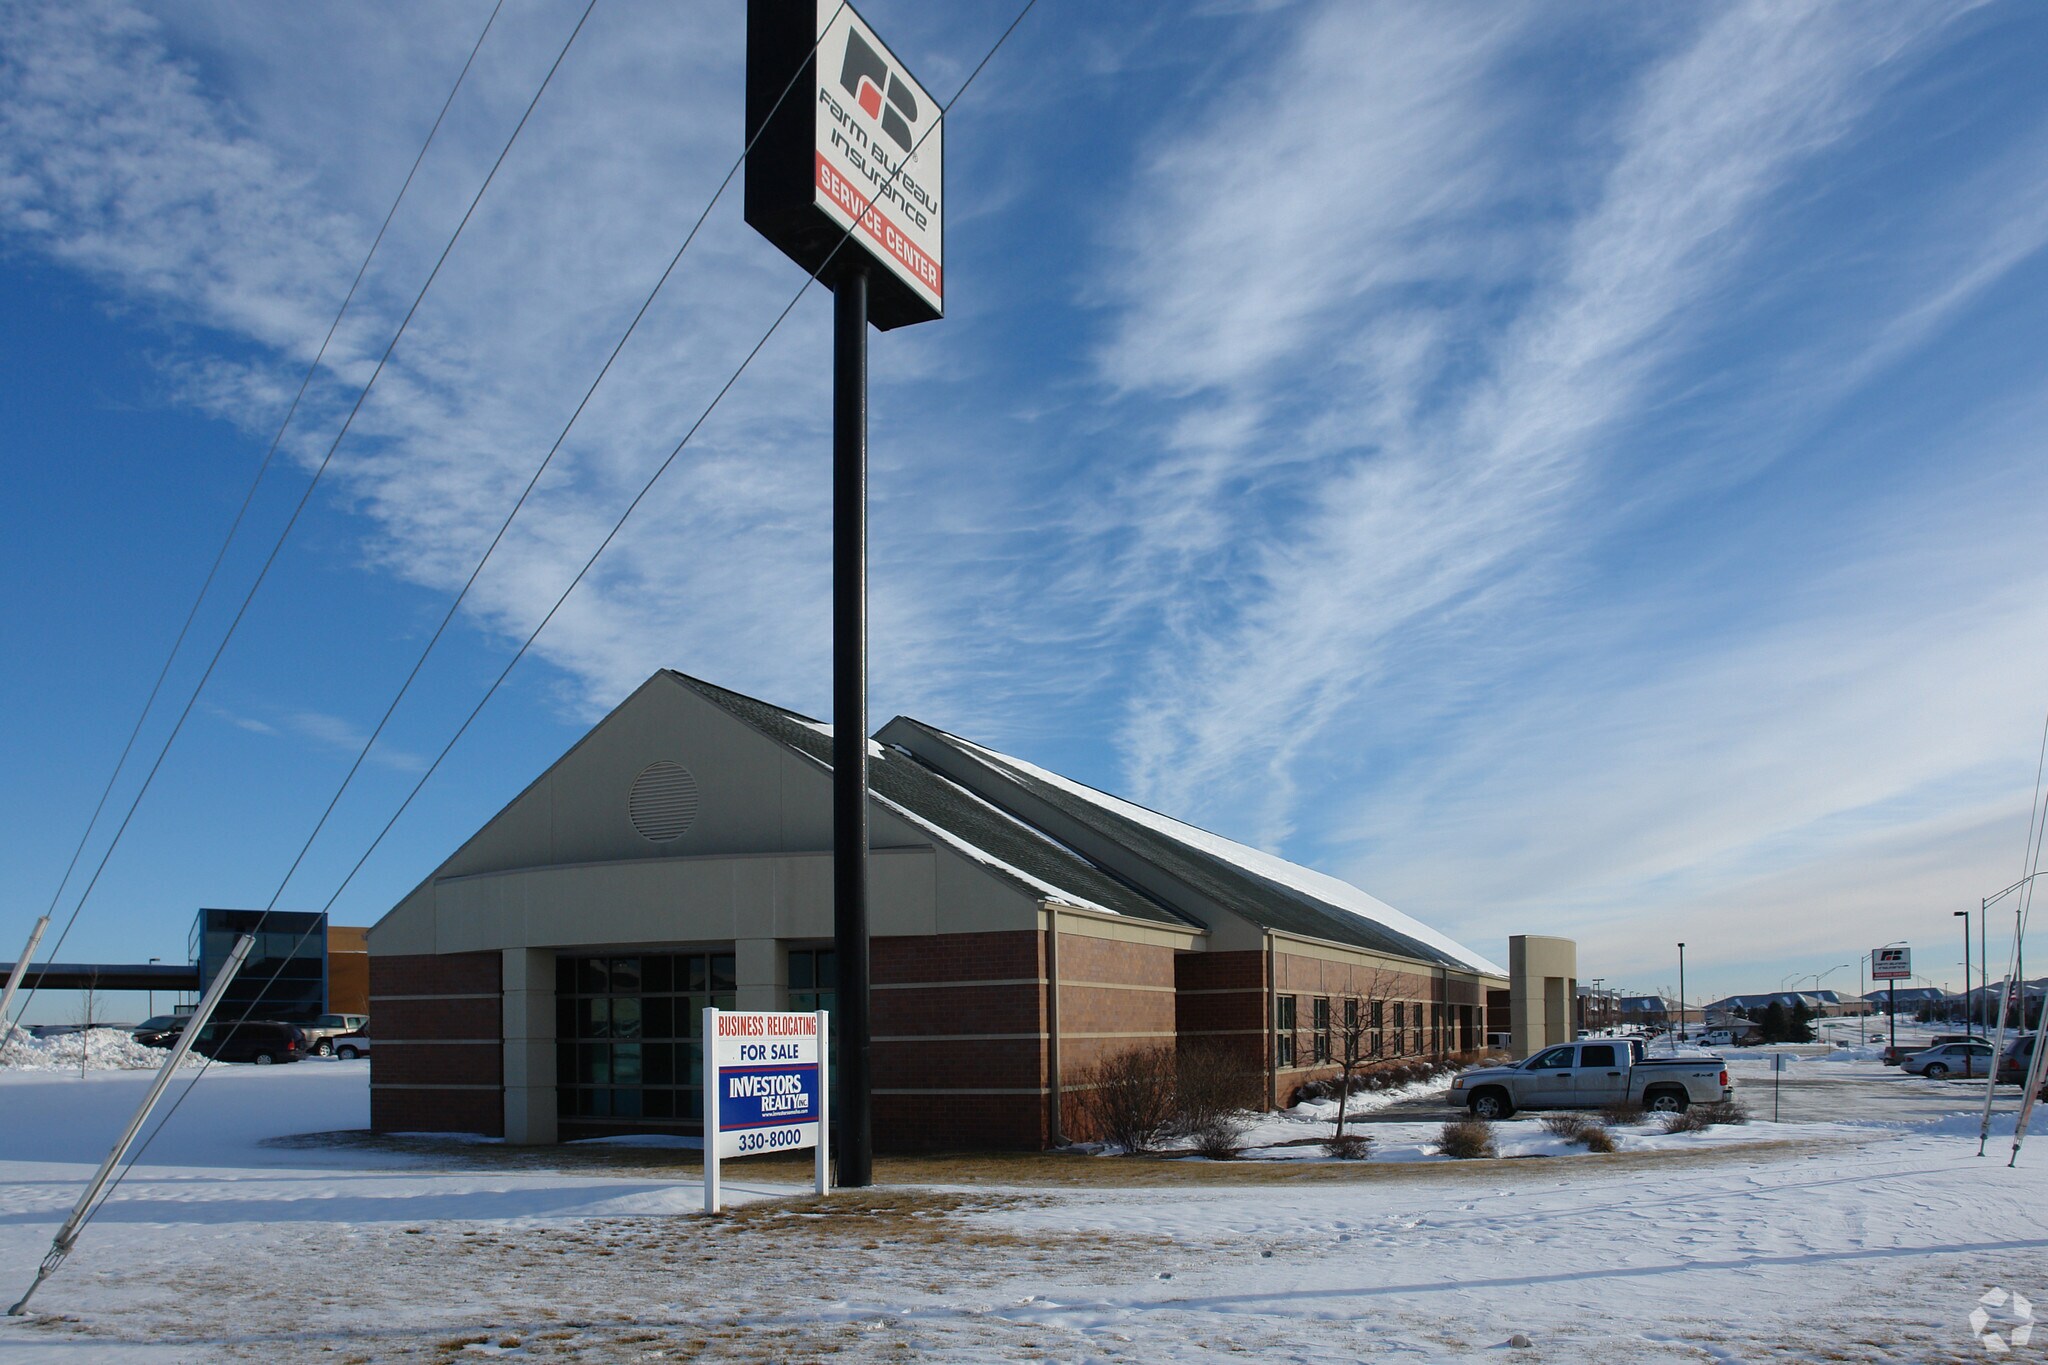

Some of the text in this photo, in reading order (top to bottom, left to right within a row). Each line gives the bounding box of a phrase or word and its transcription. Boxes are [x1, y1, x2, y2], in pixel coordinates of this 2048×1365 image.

[821, 165, 938, 288] SERVICE CENTER
[719, 1015, 817, 1036] BUSINESS RELOCATING
[740, 1044, 799, 1060] FOR SALE
[729, 1074, 802, 1098] INVESTORS
[761, 1094, 799, 1112] REALTY
[738, 1128, 801, 1151] 330-8000
